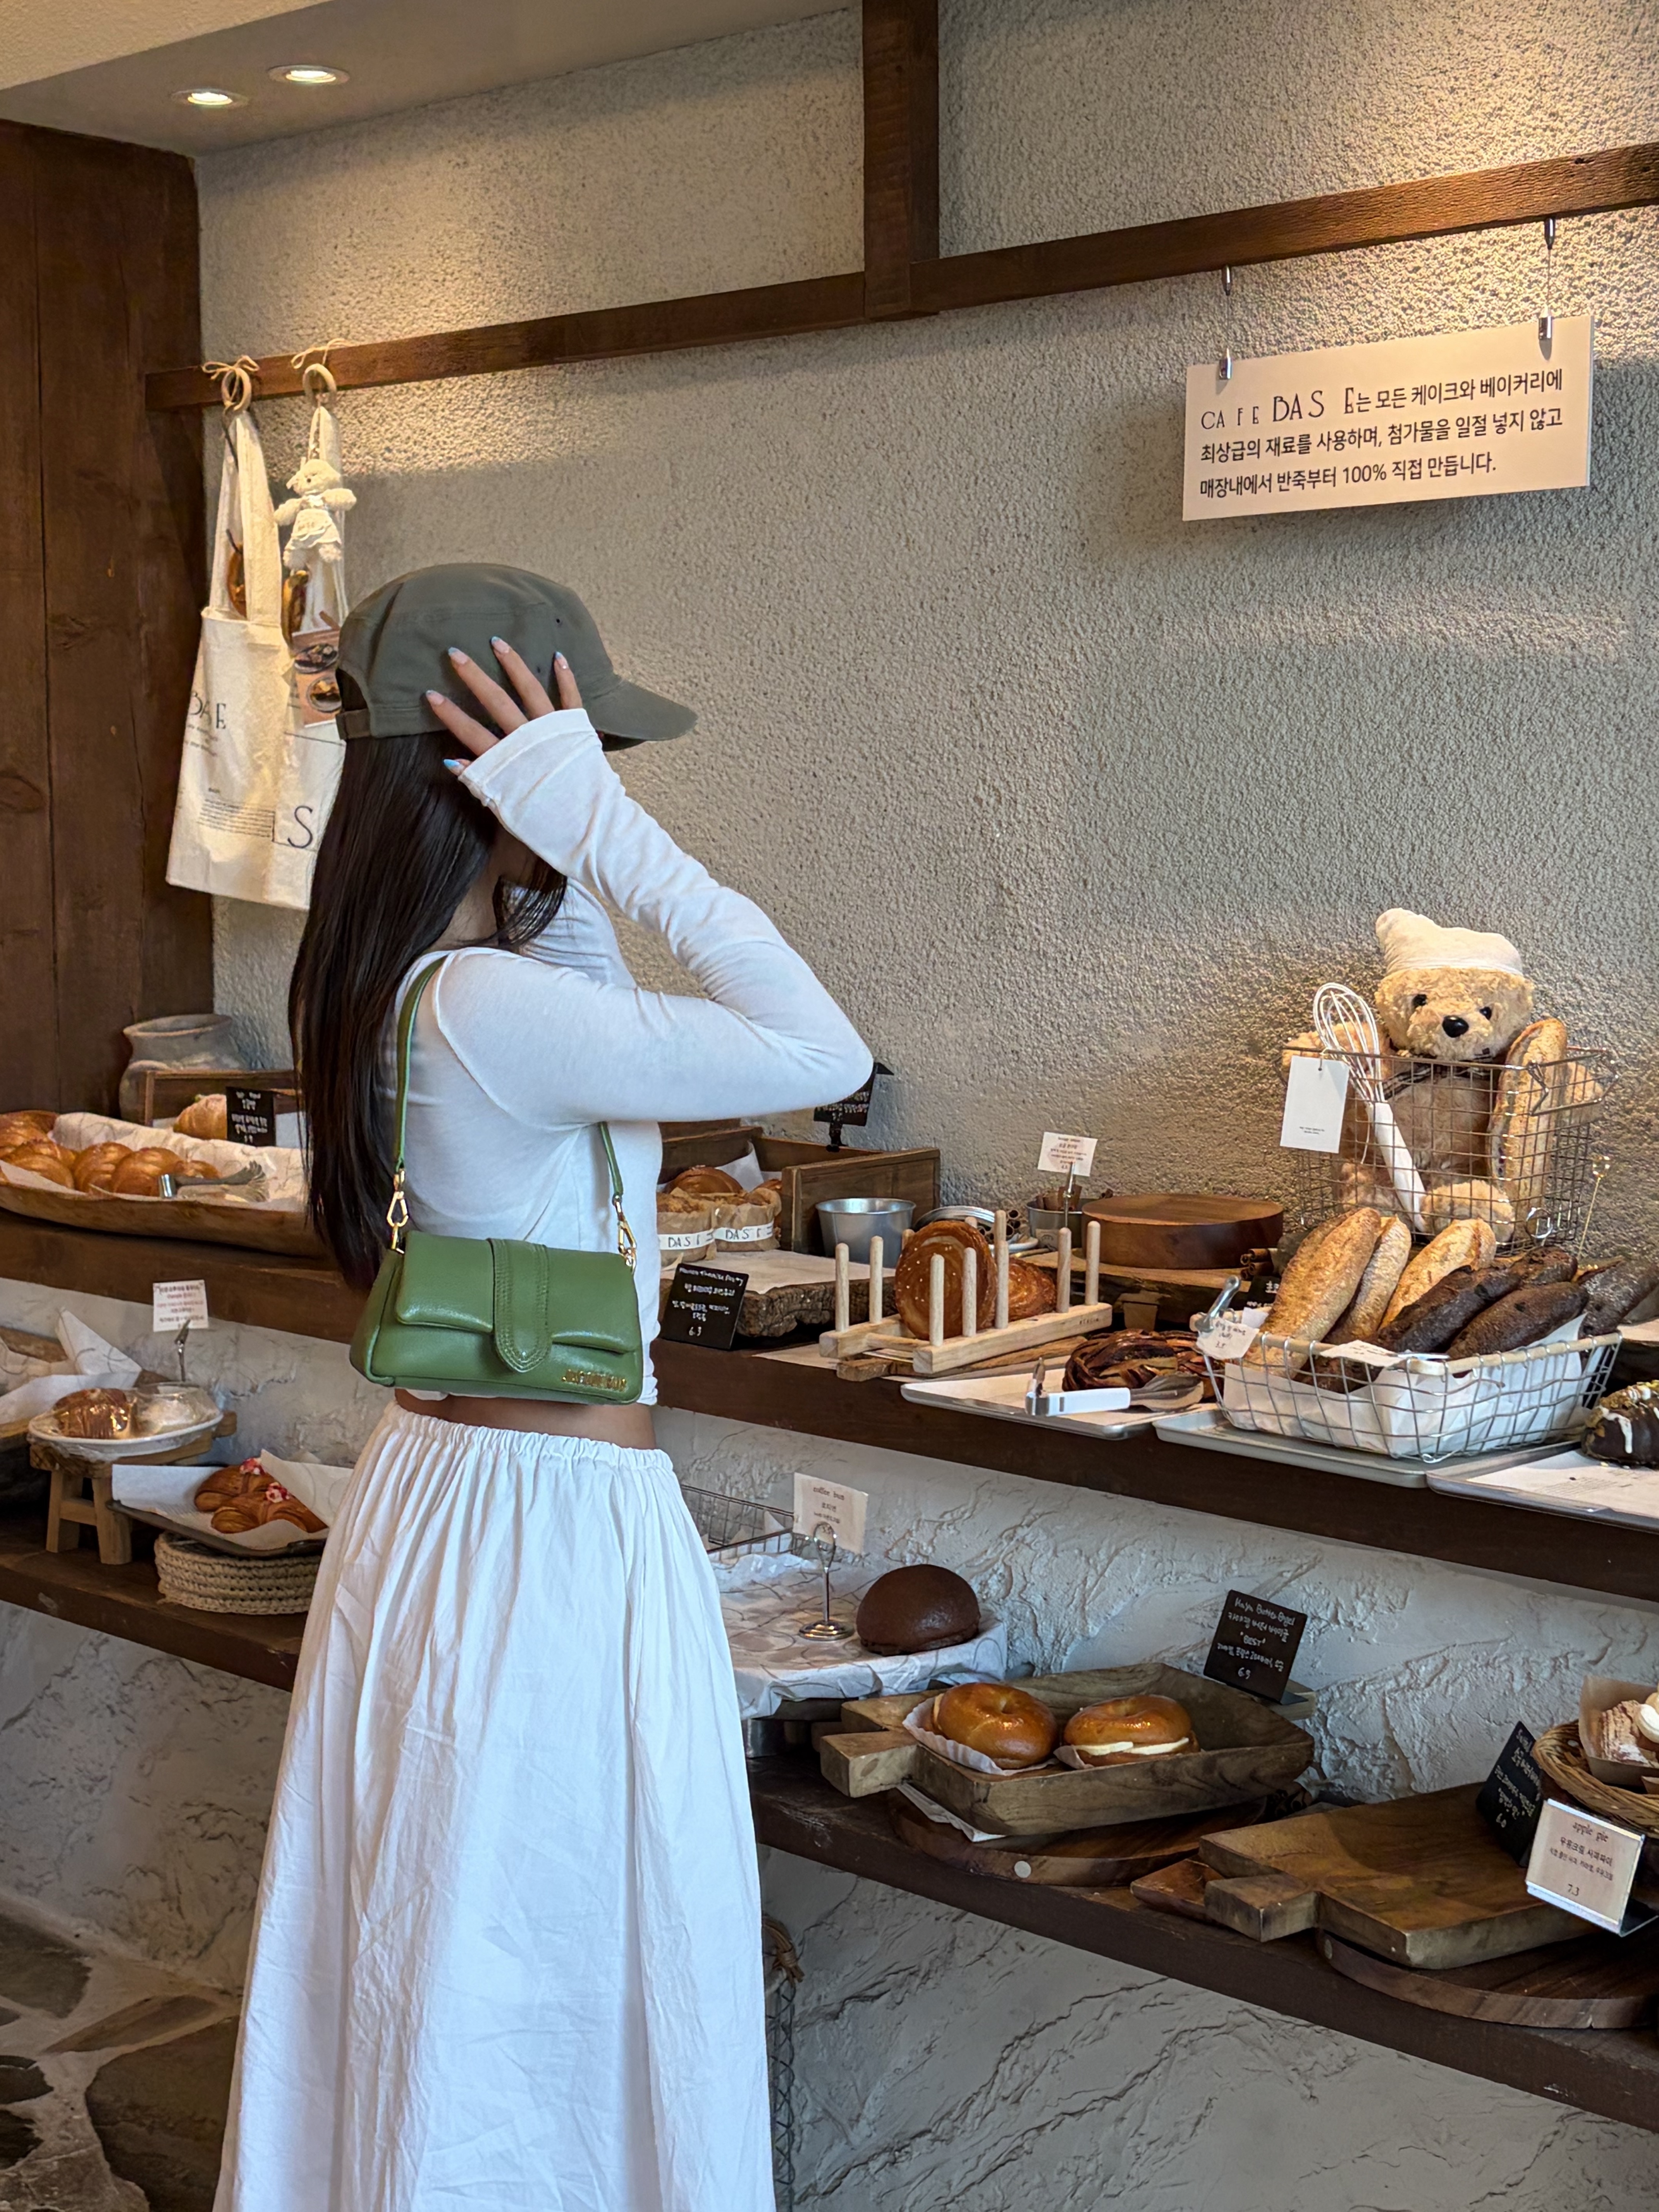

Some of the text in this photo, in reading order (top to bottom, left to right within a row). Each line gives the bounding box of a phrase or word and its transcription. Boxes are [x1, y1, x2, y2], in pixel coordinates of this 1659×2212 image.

[1201, 407, 1259, 429] CAFE
[1375, 388, 1406, 408] 모든
[1411, 379, 1475, 405] 케이크와
[1480, 368, 1562, 398] 베이커리에
[1201, 408, 1563, 464] 최상급의 재료를 사용하며, 첨가물을 일절 넣지 않고
[1201, 452, 1496, 498] 매장내에서 반죽부터 100% 직접 만듭니다.
[1573, 1822, 1609, 1842] apple pie
[1560, 1837, 1613, 1867] 우유크림 사과파이
[1567, 1883, 1580, 1896] 7.3
